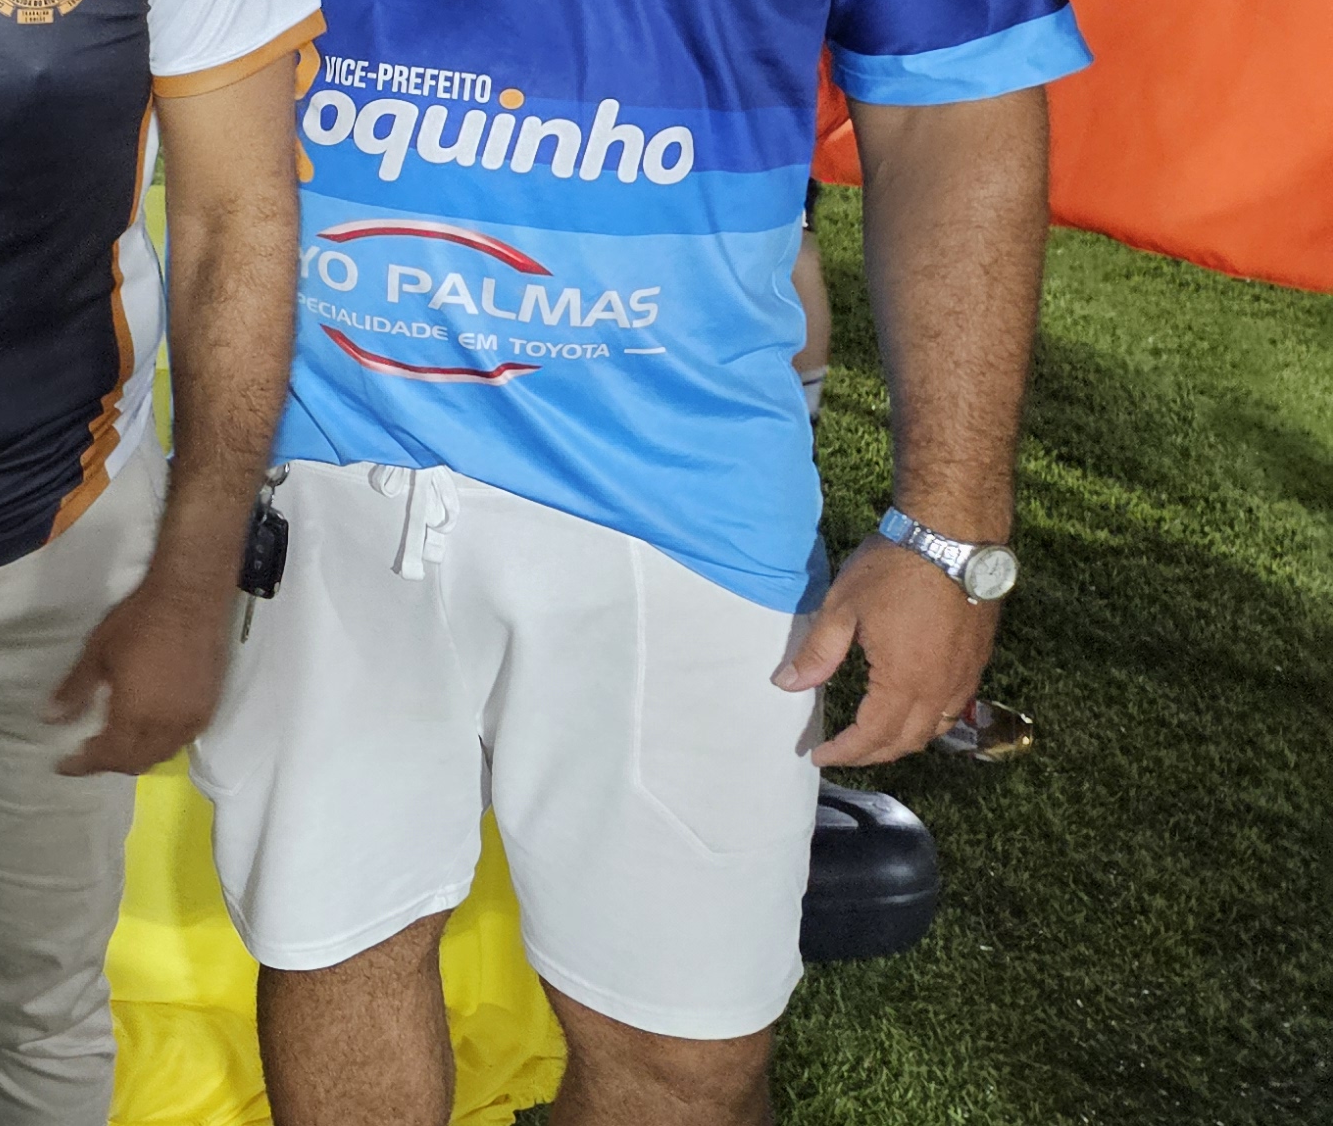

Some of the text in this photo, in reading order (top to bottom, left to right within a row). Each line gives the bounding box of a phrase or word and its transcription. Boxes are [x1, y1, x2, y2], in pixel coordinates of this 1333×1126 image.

[324, 54, 493, 104] VICE-PREFEITO
[386, 263, 661, 329] PALMAS
[457, 332, 499, 351] EM
[513, 337, 611, 359] TOYOTA
